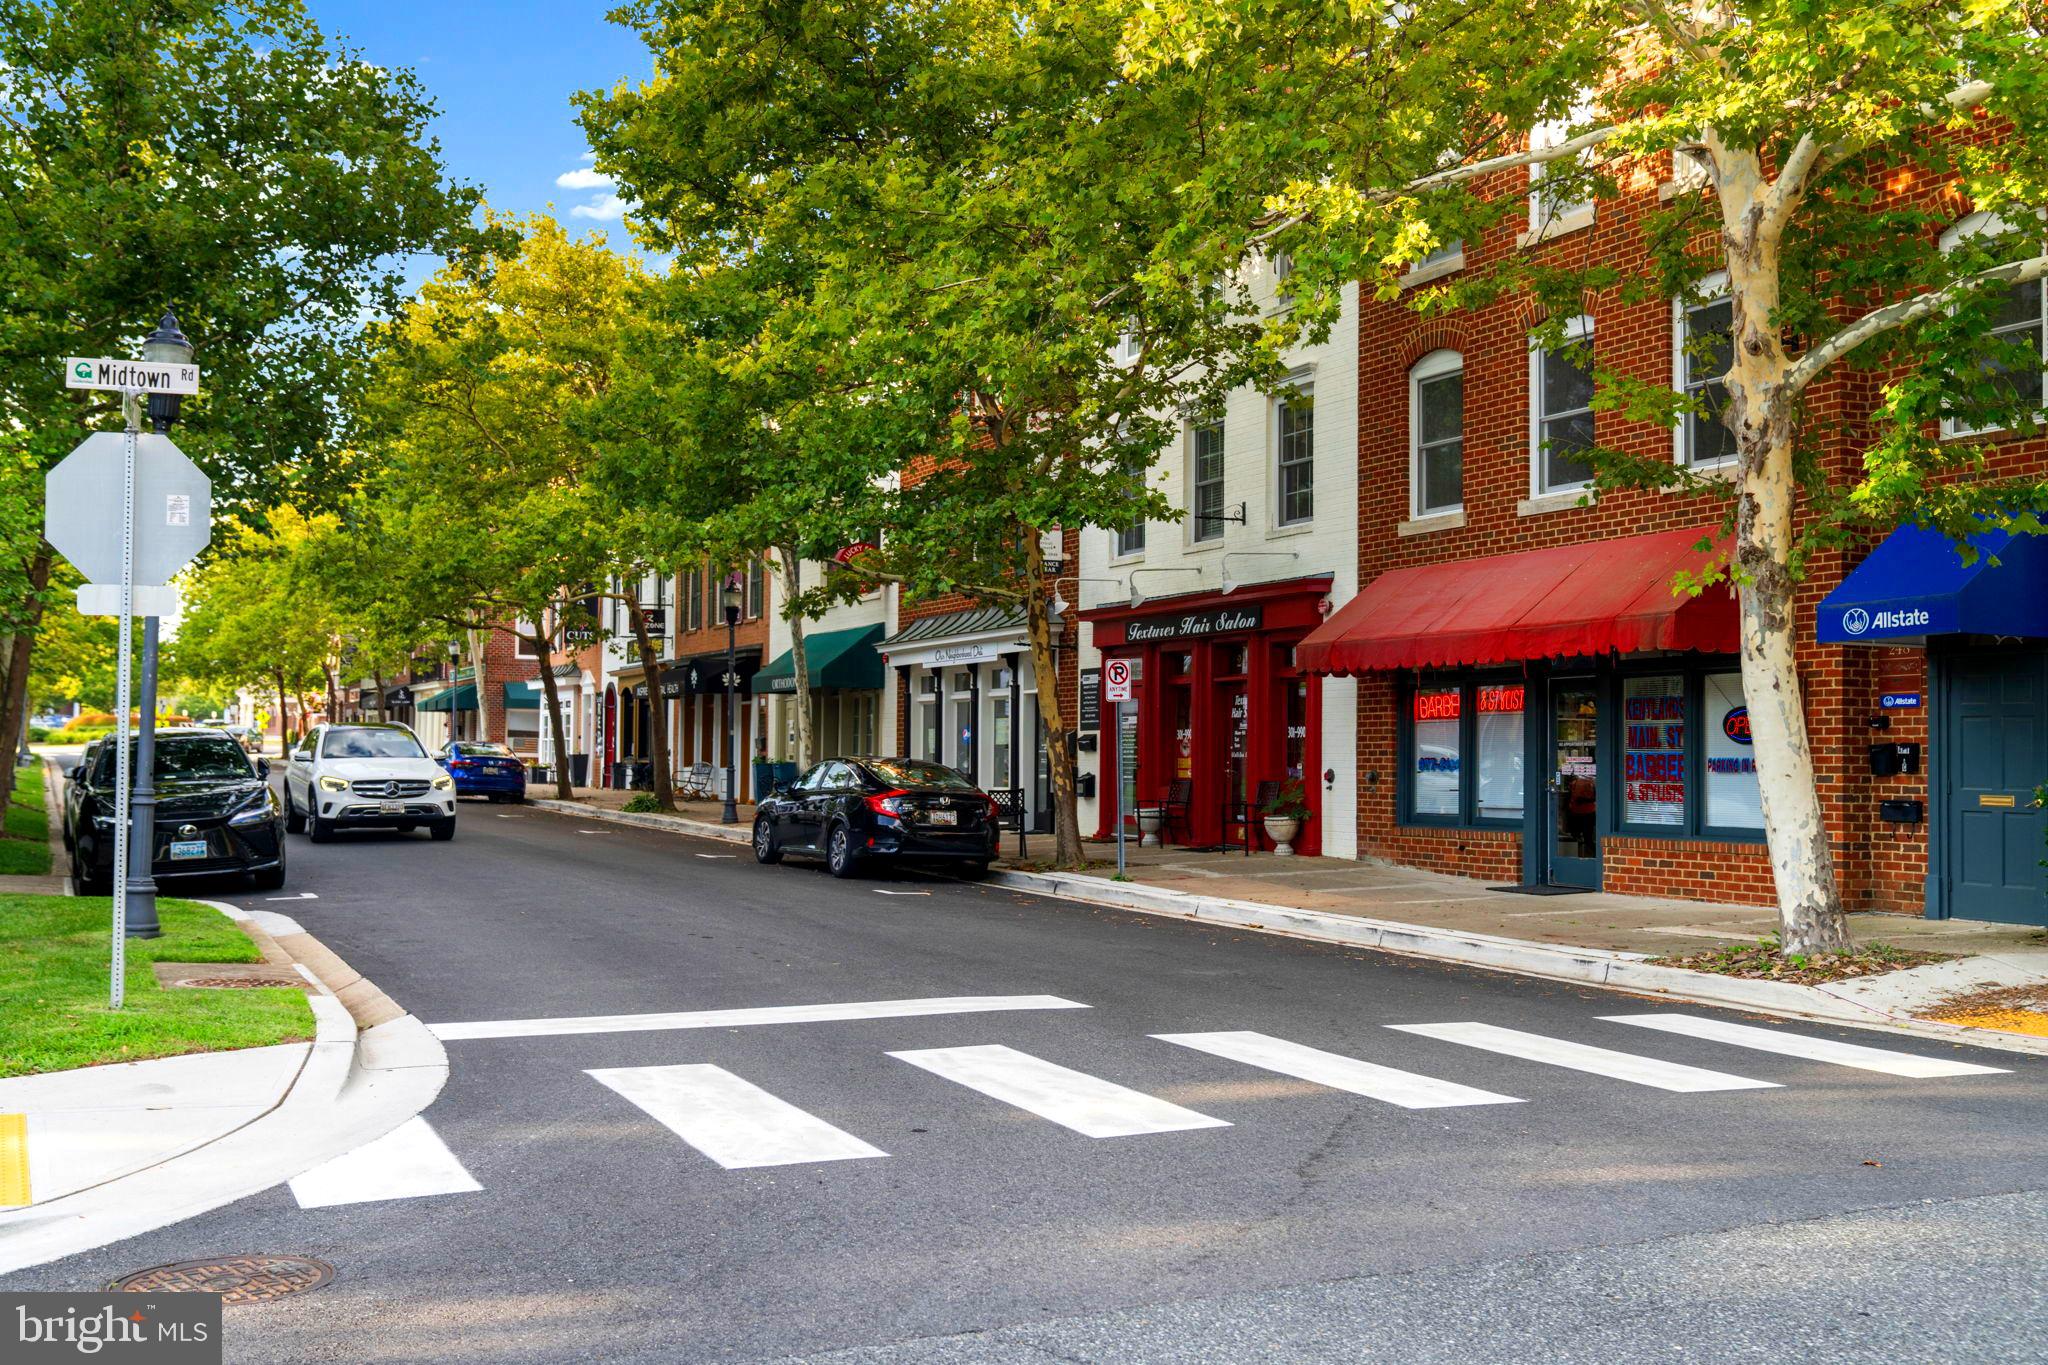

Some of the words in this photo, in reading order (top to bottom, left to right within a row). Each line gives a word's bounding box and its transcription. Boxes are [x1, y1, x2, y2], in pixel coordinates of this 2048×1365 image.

[98, 363, 170, 389] Midtown
[181, 368, 194, 381] Rd
[843, 545, 863, 560] LUCKY
[1128, 623, 1175, 641] Textures
[1180, 616, 1211, 635] Hair
[1215, 612, 1256, 631] Salon
[1872, 609, 1929, 629] Allstate
[566, 630, 594, 641] CUTS
[1419, 694, 1460, 718] BARBE
[1488, 688, 1524, 710] STYLIST
[1707, 758, 1738, 773] PARKING
